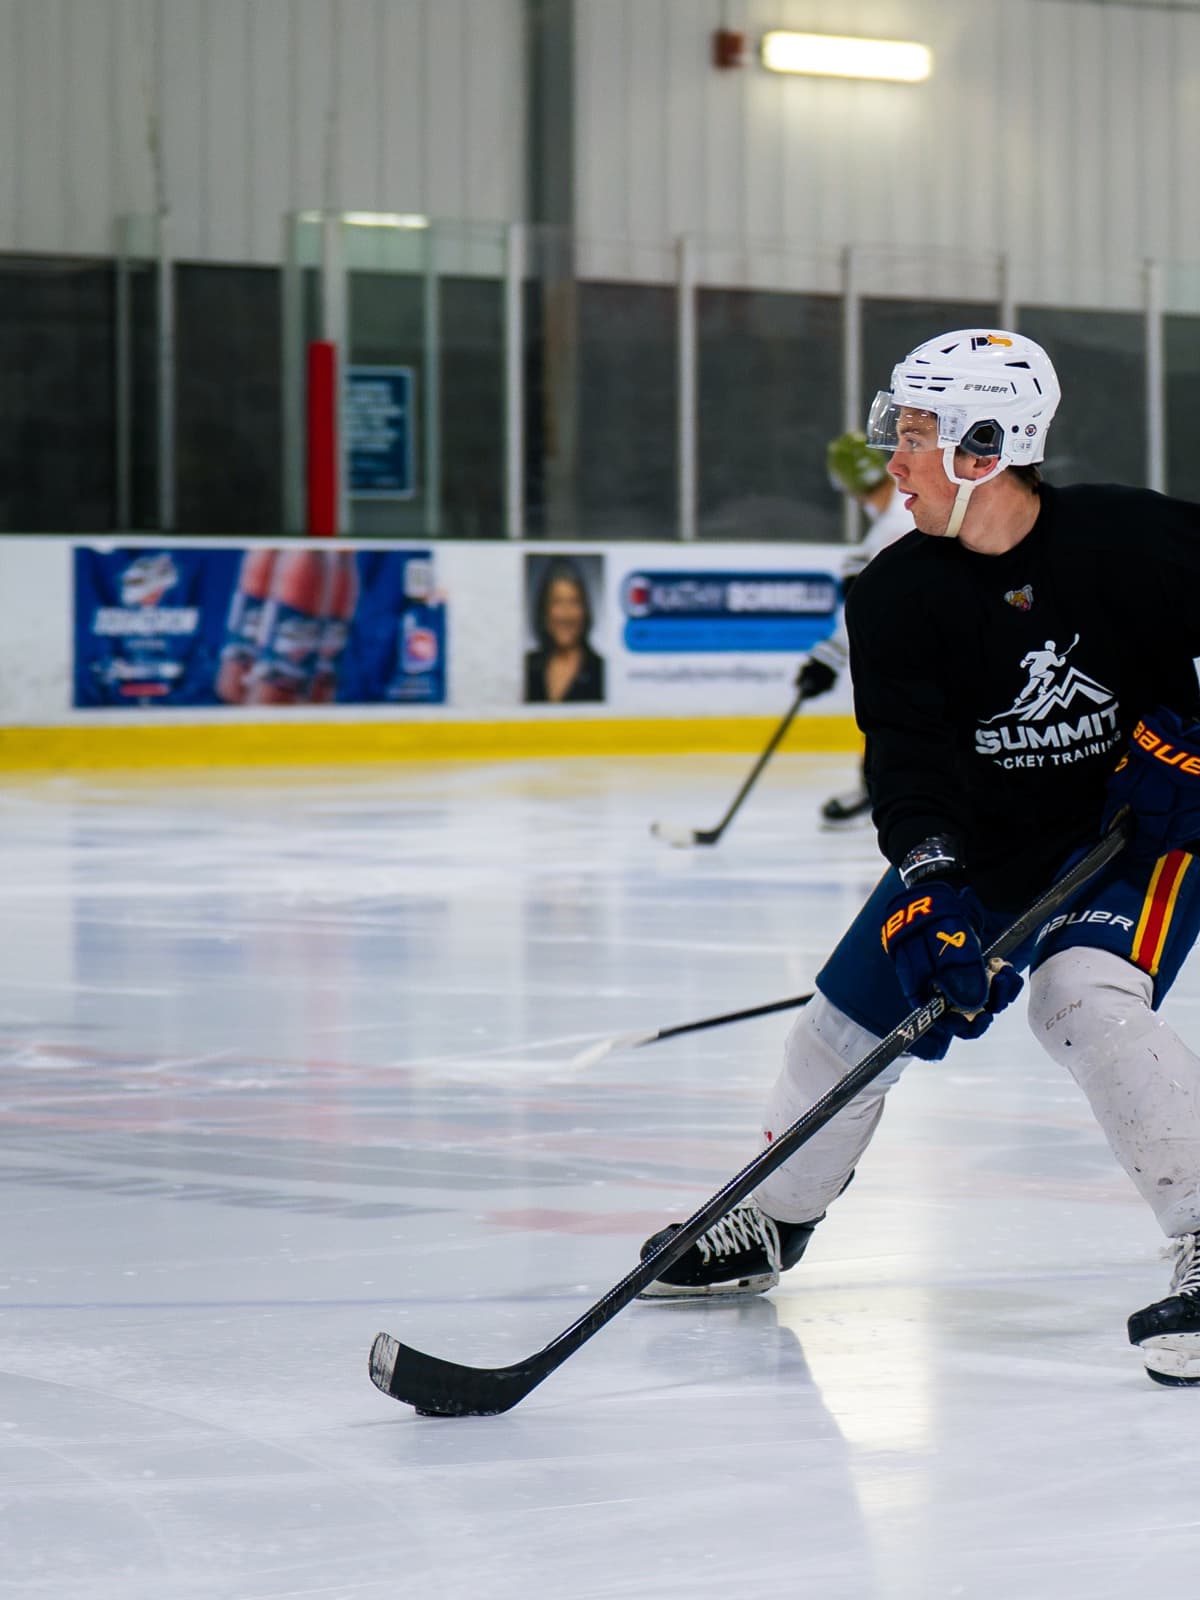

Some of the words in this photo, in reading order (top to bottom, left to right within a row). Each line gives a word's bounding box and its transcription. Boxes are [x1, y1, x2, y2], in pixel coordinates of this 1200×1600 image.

[975, 702, 1119, 755] SUMMIT
[993, 755, 1045, 769] CKEY
[1046, 1000, 1082, 1031] CCM
